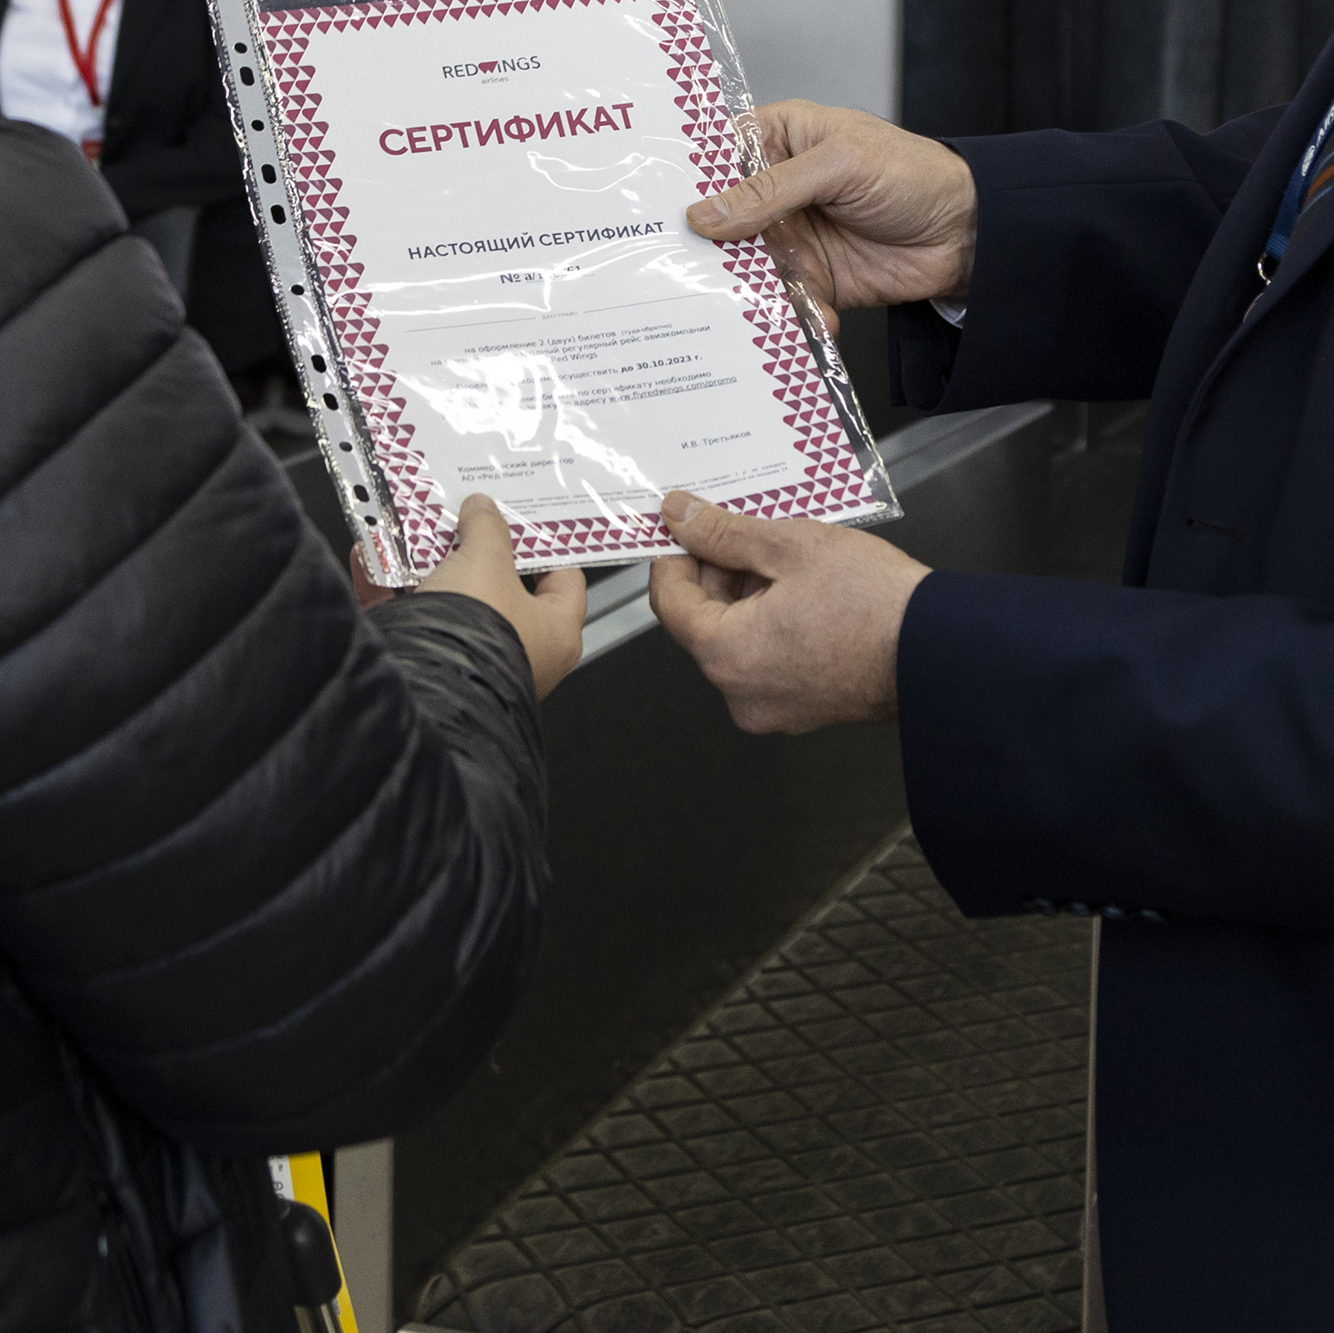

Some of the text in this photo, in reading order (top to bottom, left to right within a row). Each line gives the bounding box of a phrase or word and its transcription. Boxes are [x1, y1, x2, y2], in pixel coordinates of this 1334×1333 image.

[481, 75, 509, 85] airlines
[379, 102, 634, 156] СЕРТИФИКАТ
[408, 221, 664, 260] НАСТОЯЩИЙ СЕРТИФИКАТ
[478, 341, 537, 354] оформление
[539, 339, 545, 347] 2
[547, 336, 576, 347] (двух)
[578, 330, 617, 342] билетов
[562, 339, 619, 354] регулярный
[620, 335, 643, 346] рейс
[644, 324, 712, 342] авиакомпании
[570, 351, 598, 362] Wings
[620, 365, 634, 374] до
[636, 354, 692, 371] 30.10.2023
[655, 370, 712, 387] необходимо
[702, 430, 752, 447] Третьяков
